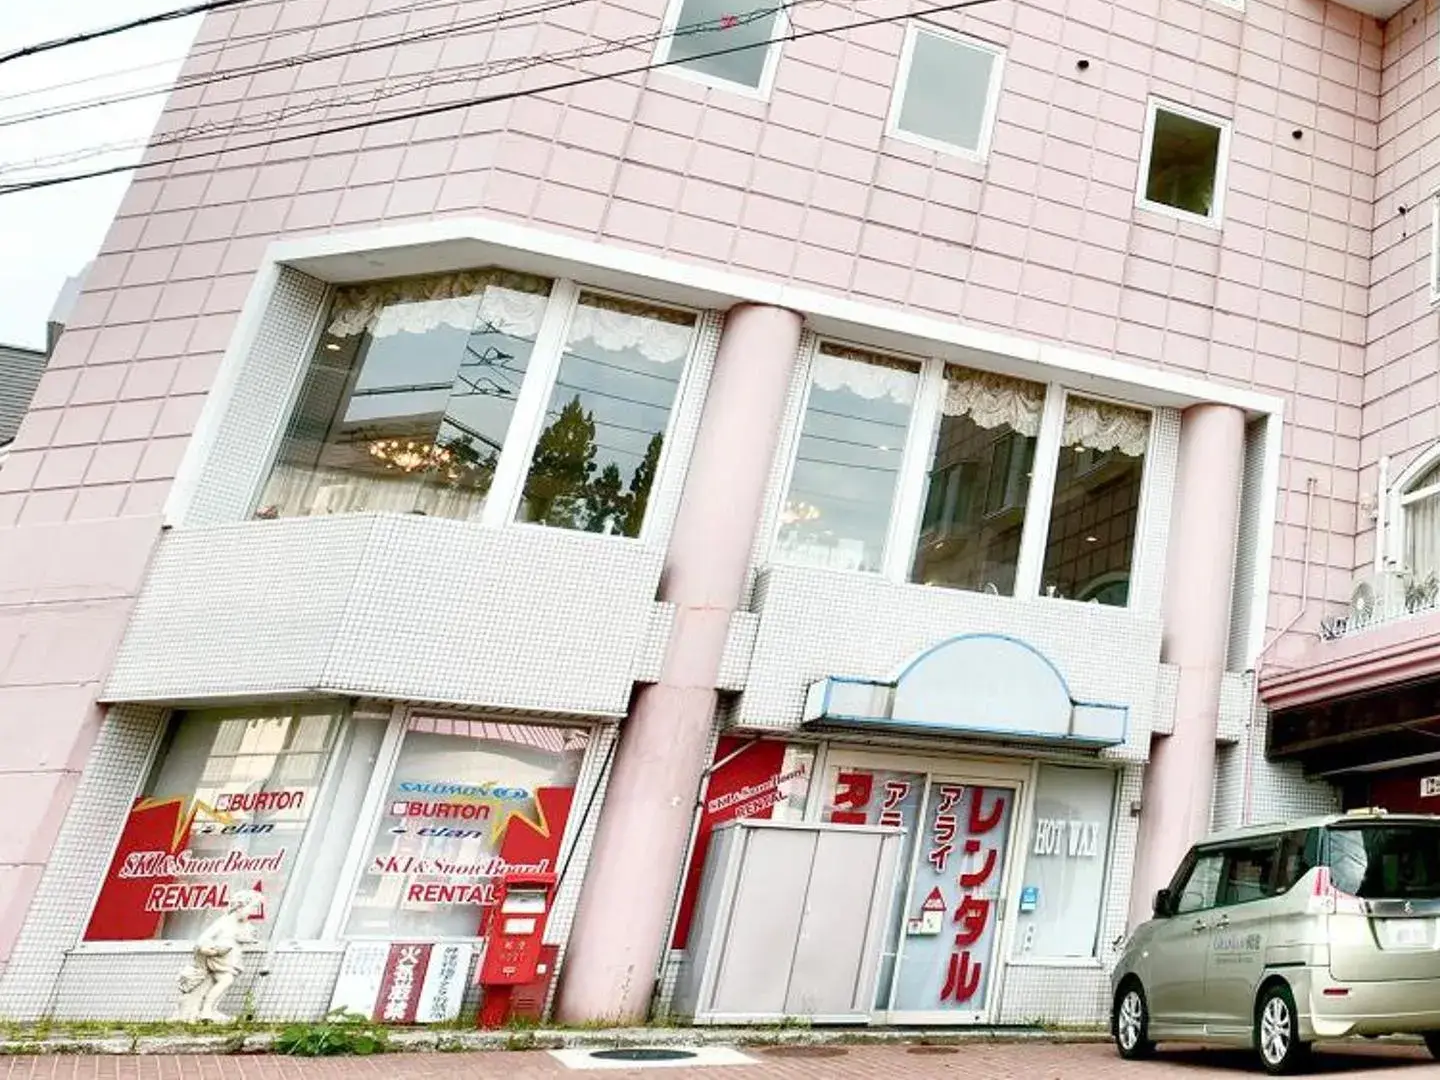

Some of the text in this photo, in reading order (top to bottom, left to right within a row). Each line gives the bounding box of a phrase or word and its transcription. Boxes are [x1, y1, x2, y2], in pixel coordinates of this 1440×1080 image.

[399, 781, 489, 798] SALOMON
[229, 791, 305, 813] BURTON
[409, 800, 491, 820] BURTON
[735, 789, 788, 819] RENTAL
[221, 822, 275, 836] elan
[416, 826, 483, 840] elan
[929, 785, 965, 872] アライ
[1034, 818, 1100, 857] HOT WAX
[146, 882, 231, 912] RENTAL
[406, 882, 498, 905] RENTAL
[939, 786, 1005, 1003] レンタル
